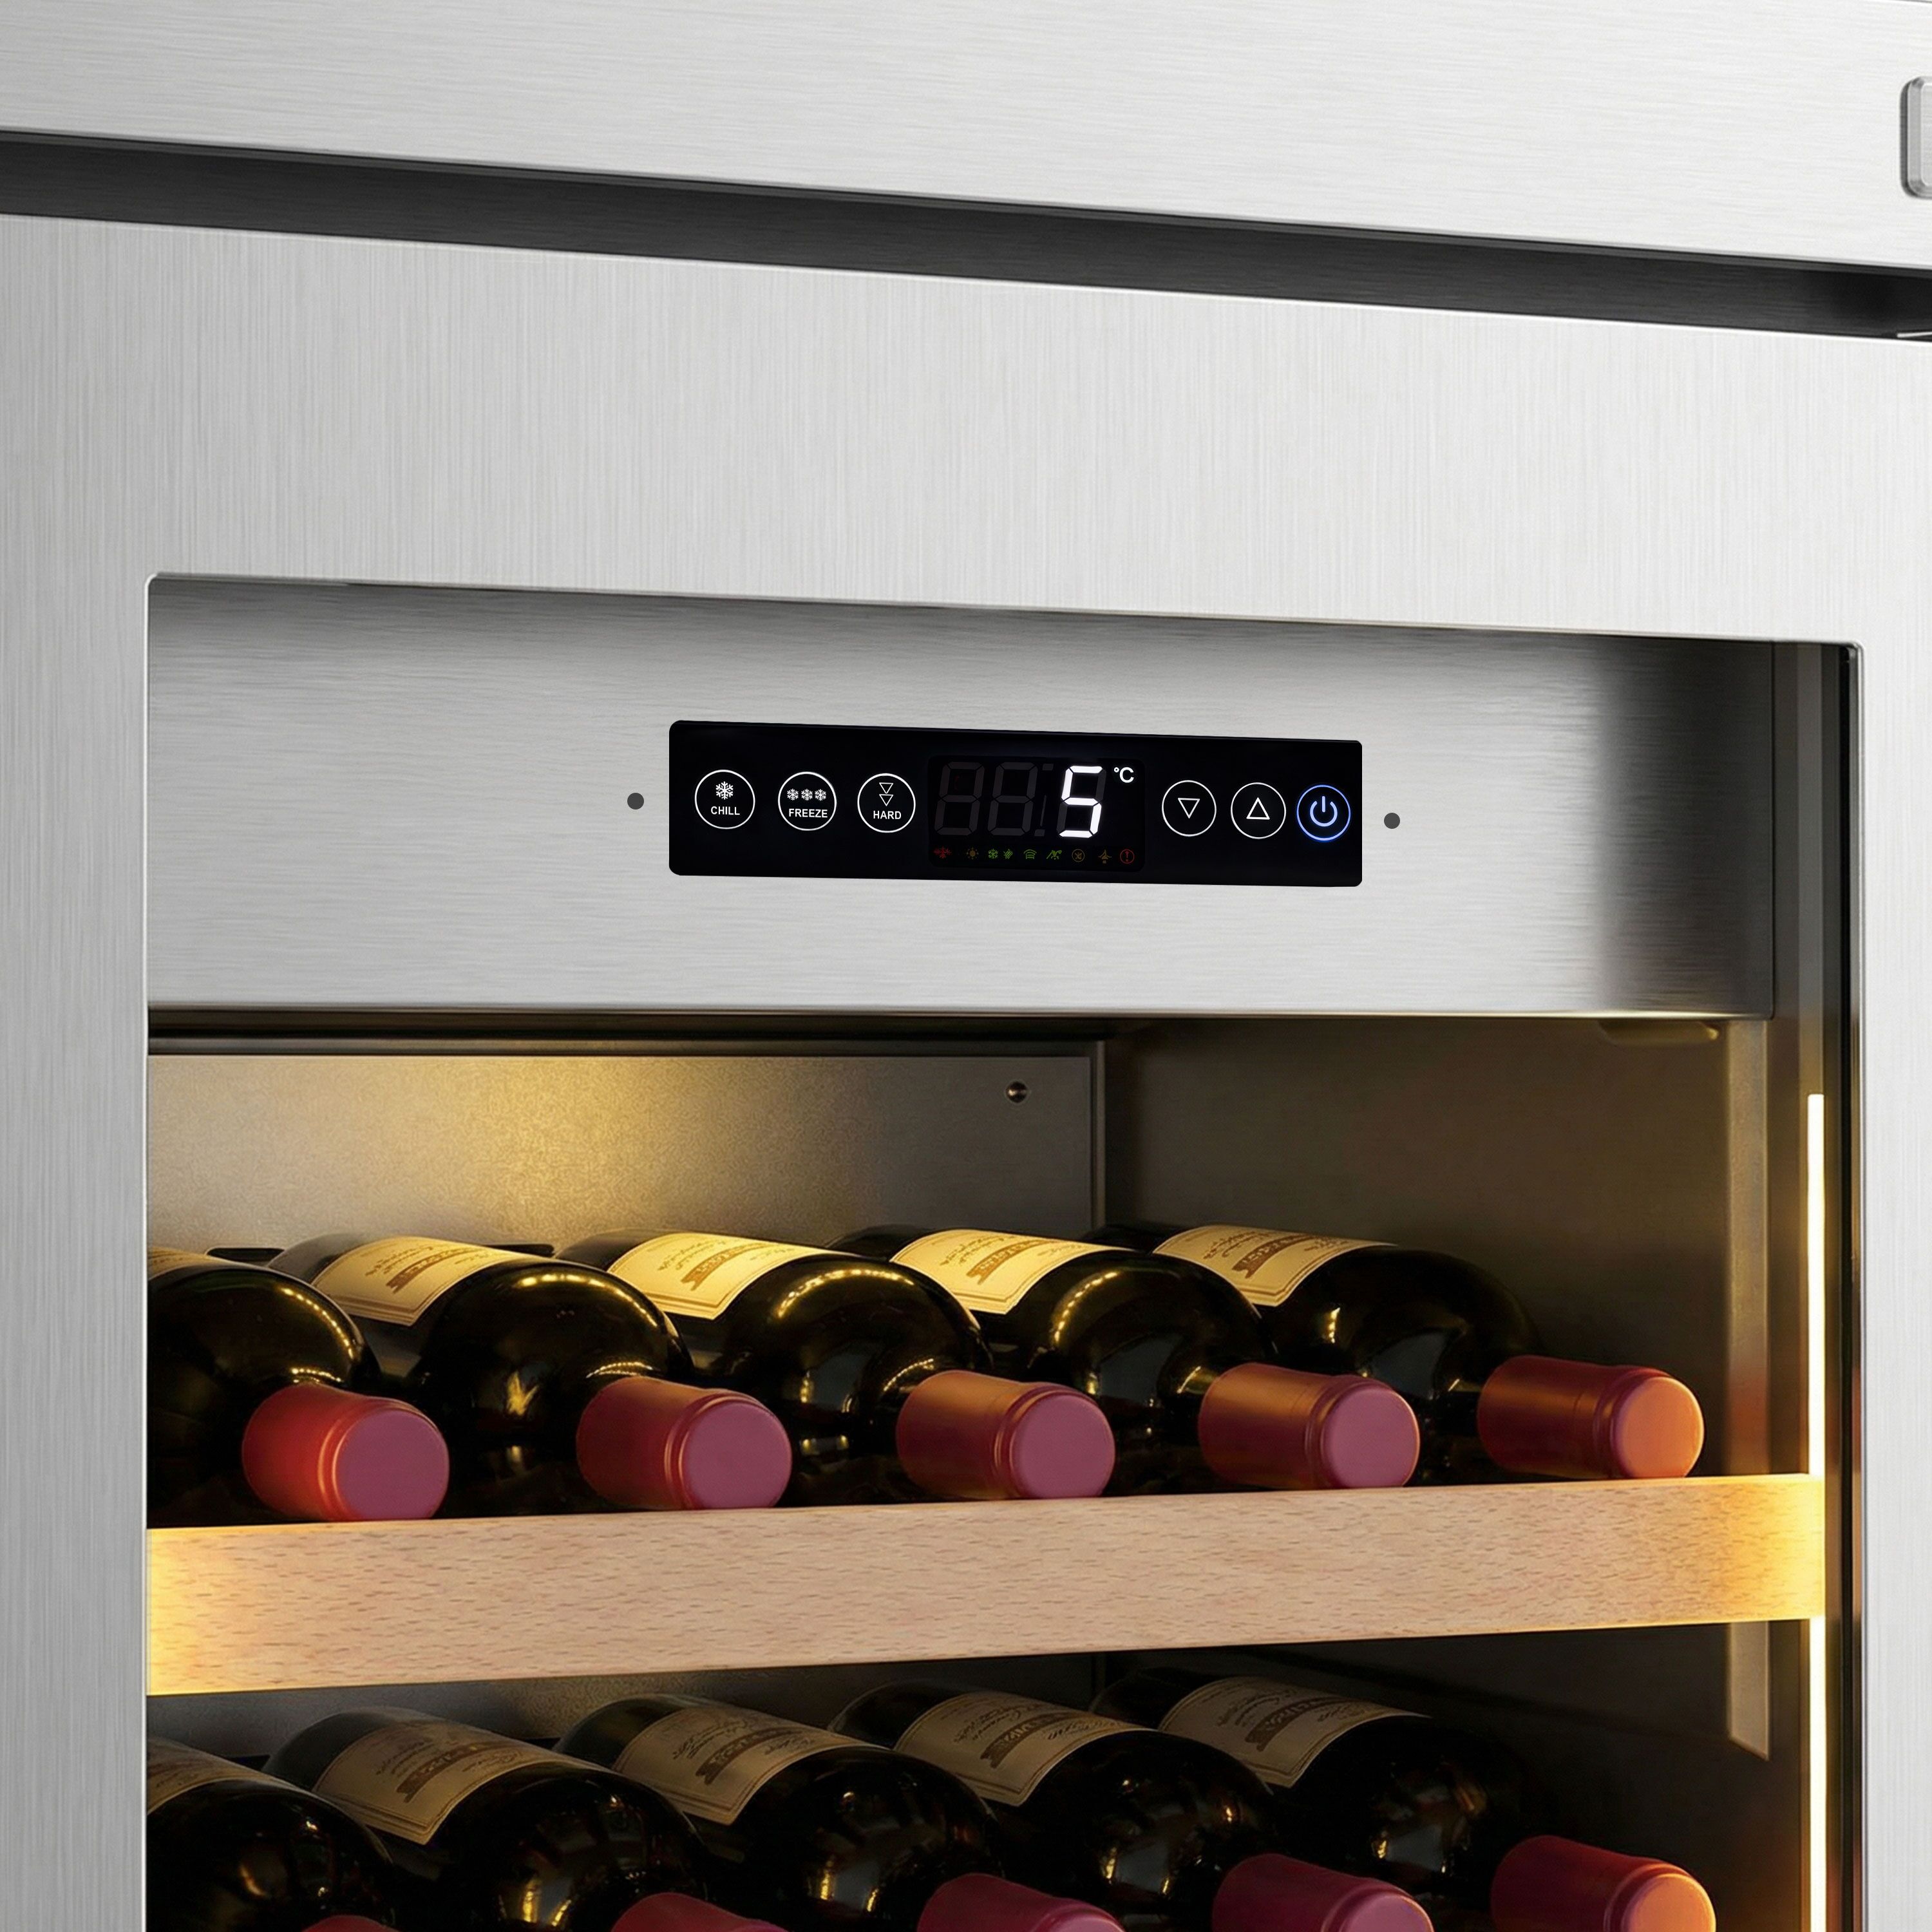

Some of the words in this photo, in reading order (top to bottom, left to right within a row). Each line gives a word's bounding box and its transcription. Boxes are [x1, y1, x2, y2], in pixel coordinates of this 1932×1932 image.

[1059, 765, 1103, 838] 5
[1113, 766, 1134, 783] °C
[710, 806, 741, 815] CHILL
[788, 808, 828, 819] FREEZE
[873, 810, 902, 820] HARD
